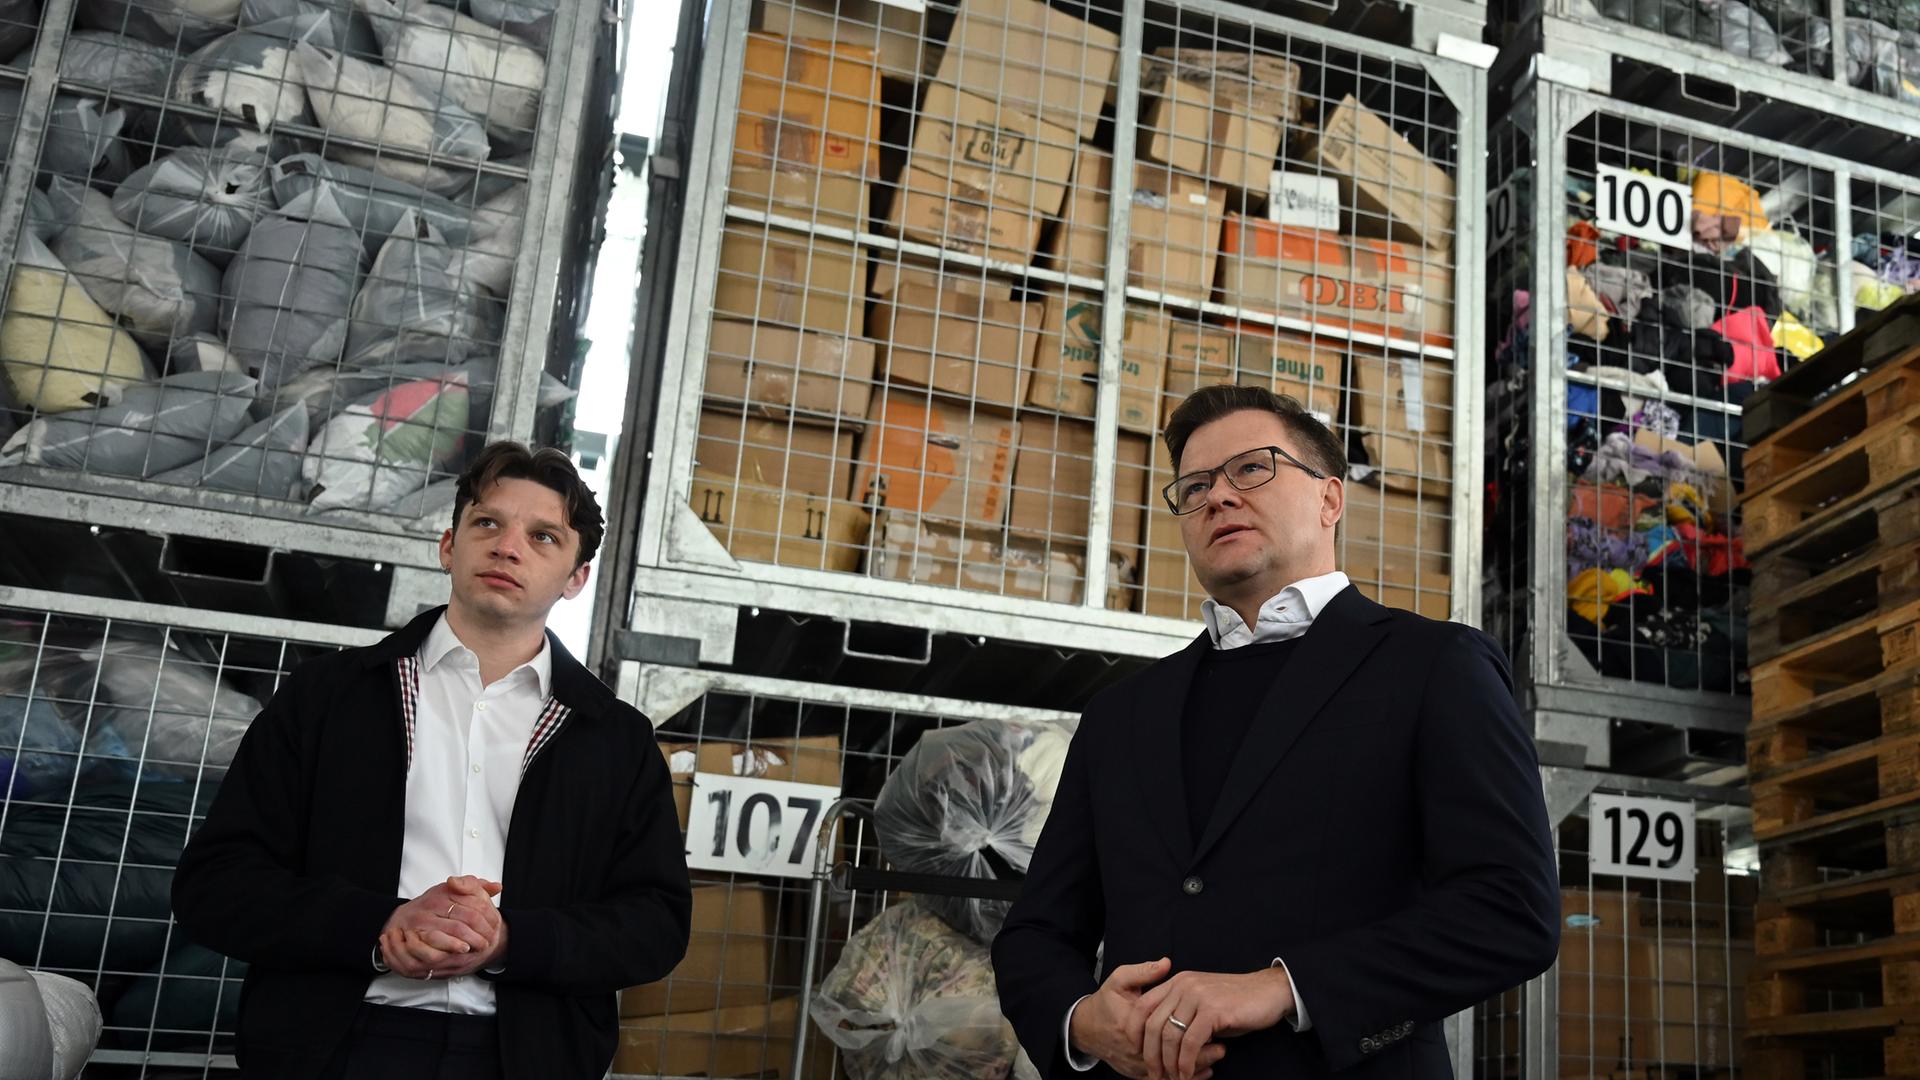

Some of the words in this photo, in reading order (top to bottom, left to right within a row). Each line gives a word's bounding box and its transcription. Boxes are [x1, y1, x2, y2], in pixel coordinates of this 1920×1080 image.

[1603, 175, 1684, 236] 100
[1299, 275, 1405, 314] OBI
[708, 789, 823, 866] 107
[1604, 807, 1684, 869] 129
